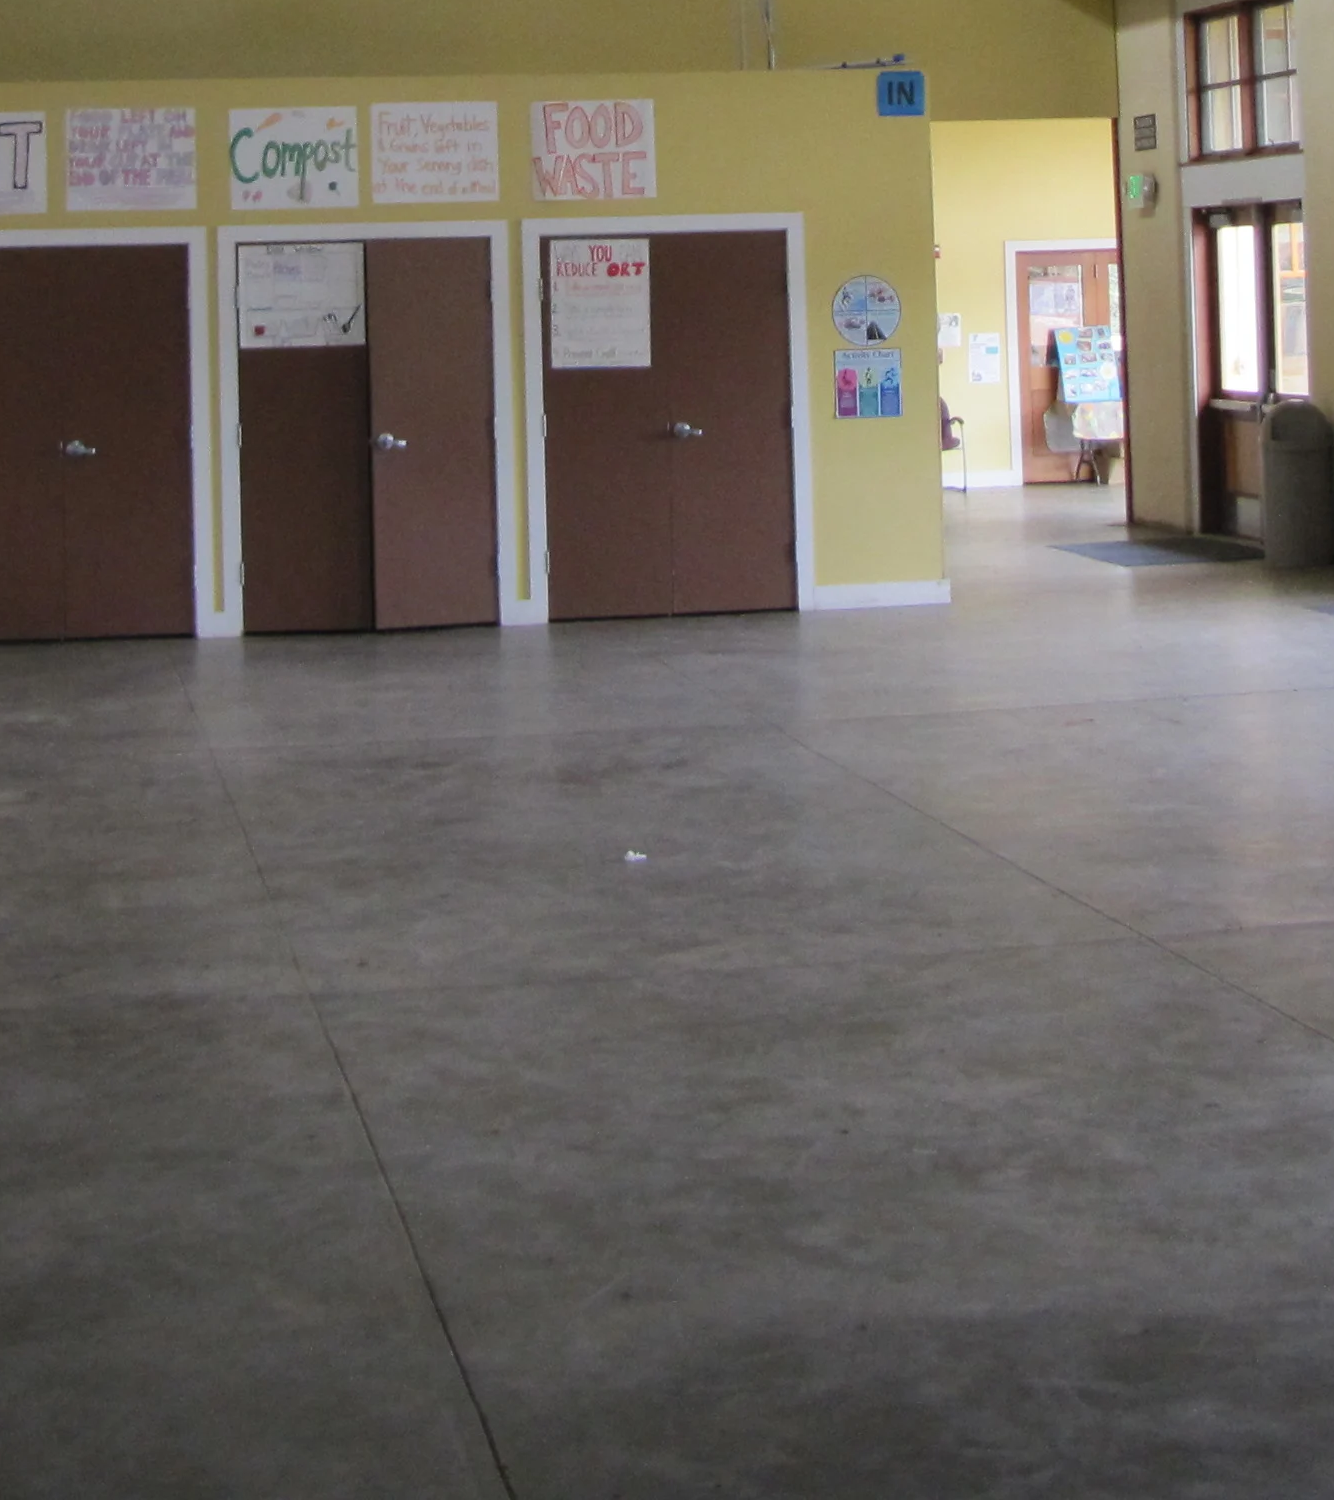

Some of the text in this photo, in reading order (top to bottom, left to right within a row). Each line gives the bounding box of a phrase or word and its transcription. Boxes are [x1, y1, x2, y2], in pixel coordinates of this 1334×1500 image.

[887, 80, 915, 106] IN
[420, 112, 490, 140] Vegetables
[543, 102, 643, 154] FOOD
[467, 140, 483, 152] in
[229, 127, 357, 201] Compost
[121, 168, 153, 186] THE
[531, 151, 647, 199] WASTE
[421, 180, 444, 195] end
[588, 244, 613, 262] YOU
[556, 261, 646, 278] REDUCE ORT
[872, 350, 895, 359] Chart
